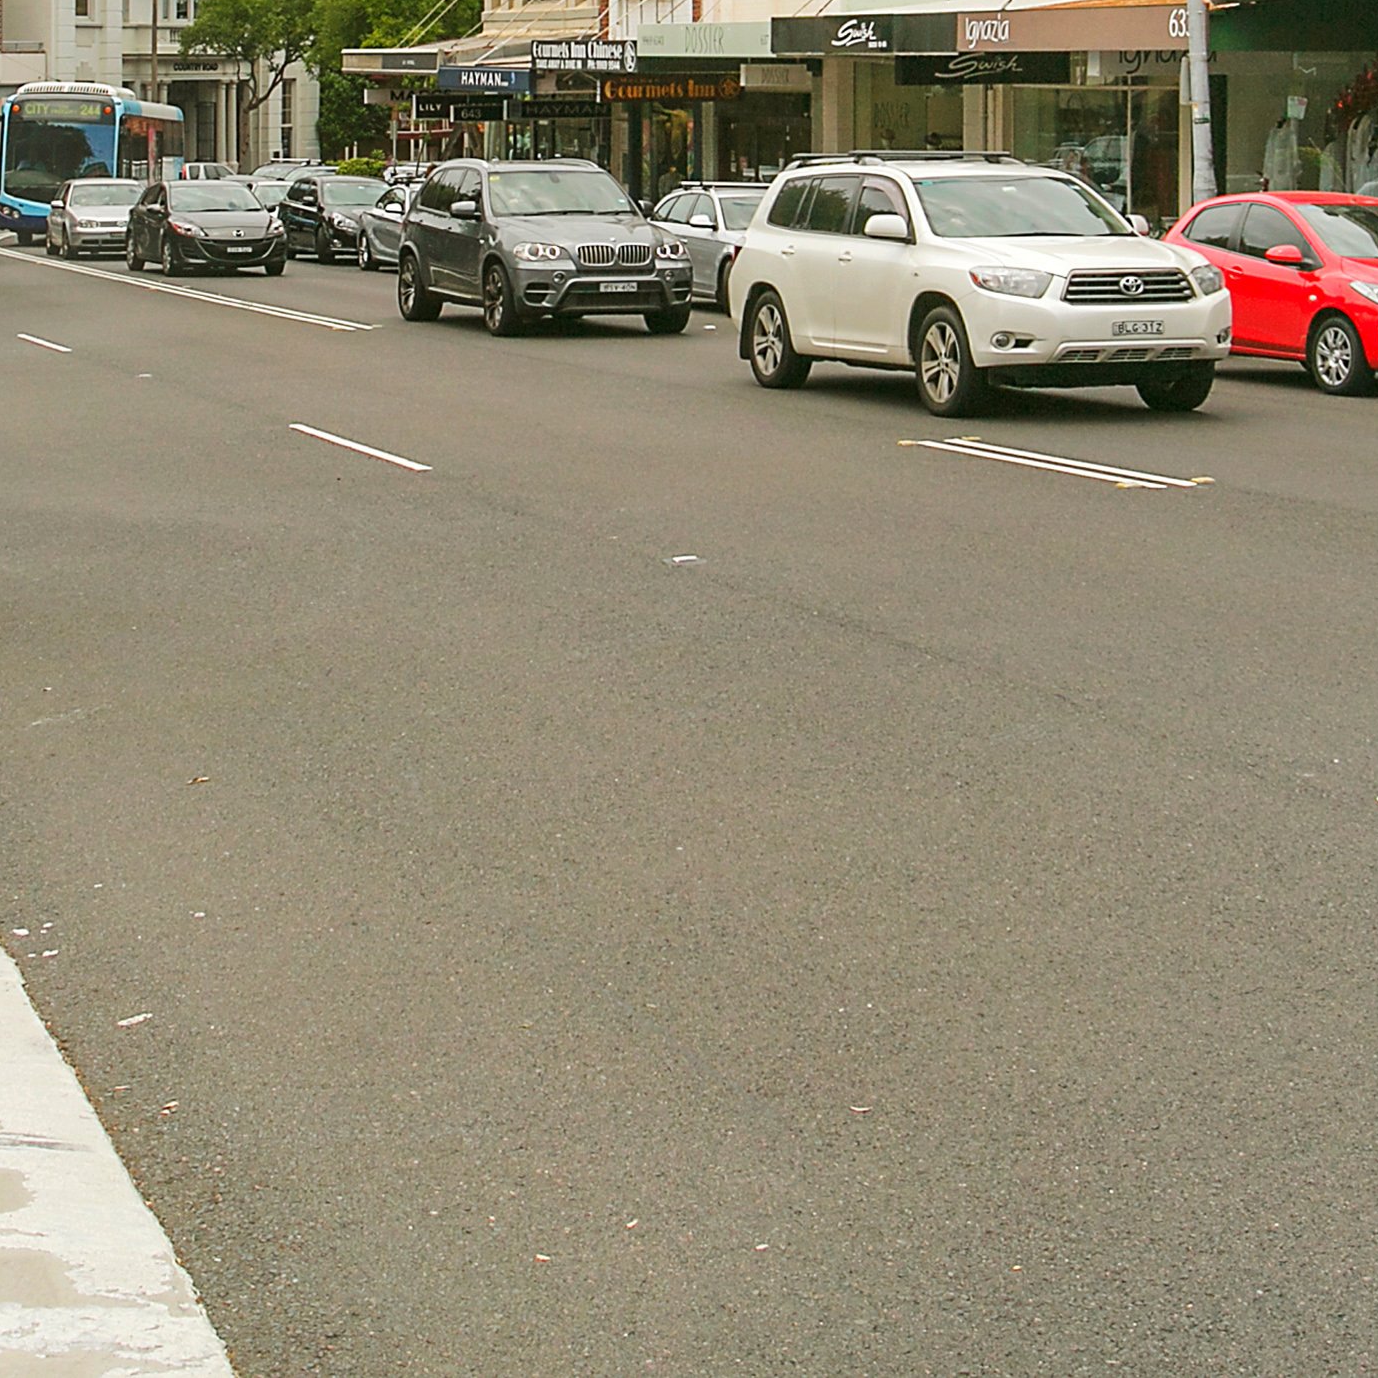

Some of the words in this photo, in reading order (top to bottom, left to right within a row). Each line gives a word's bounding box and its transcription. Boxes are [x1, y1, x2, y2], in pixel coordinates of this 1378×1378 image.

[685, 25, 725, 54] DOSSIER
[831, 19, 877, 47] Swish
[965, 13, 1010, 50] Ignazia
[570, 41, 587, 59] Inn
[587, 41, 623, 60] Chinese
[934, 52, 1023, 79] Swish
[461, 71, 501, 86] HAYMAN
[604, 80, 684, 99] Gourmets
[687, 79, 716, 98] Inn
[24, 103, 50, 115] CITY
[419, 103, 442, 111] LILY
[461, 110, 482, 119] 643
[526, 105, 607, 115] HAYMAN
